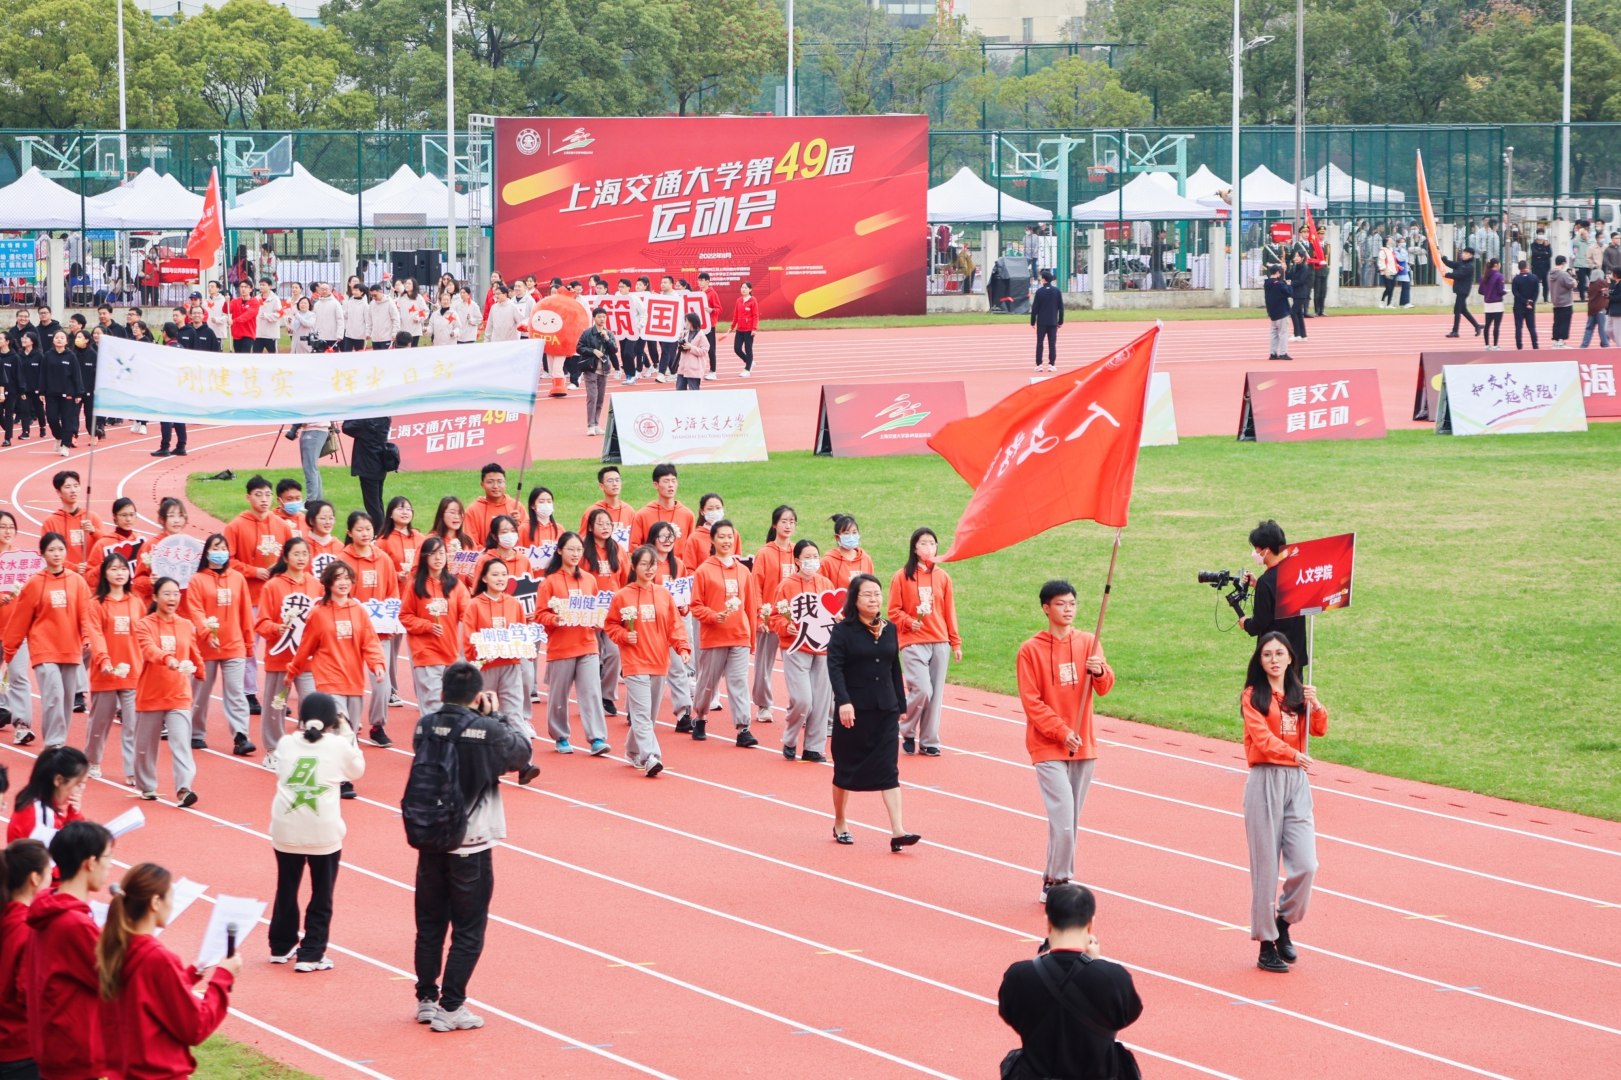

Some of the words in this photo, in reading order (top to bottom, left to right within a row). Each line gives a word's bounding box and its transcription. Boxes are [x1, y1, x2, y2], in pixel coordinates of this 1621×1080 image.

[559, 137, 856, 213] 上海交通大学第49届
[647, 189, 777, 244] 运动会
[645, 299, 680, 337] 国
[1580, 363, 1616, 397] 海
[1286, 405, 1350, 433] 爱运动
[426, 431, 487, 454] 运动会
[528, 544, 558, 559] 人文
[0, 573, 33, 585] 国荣
[1296, 564, 1333, 586] 人文学院
[793, 595, 818, 621] 我
